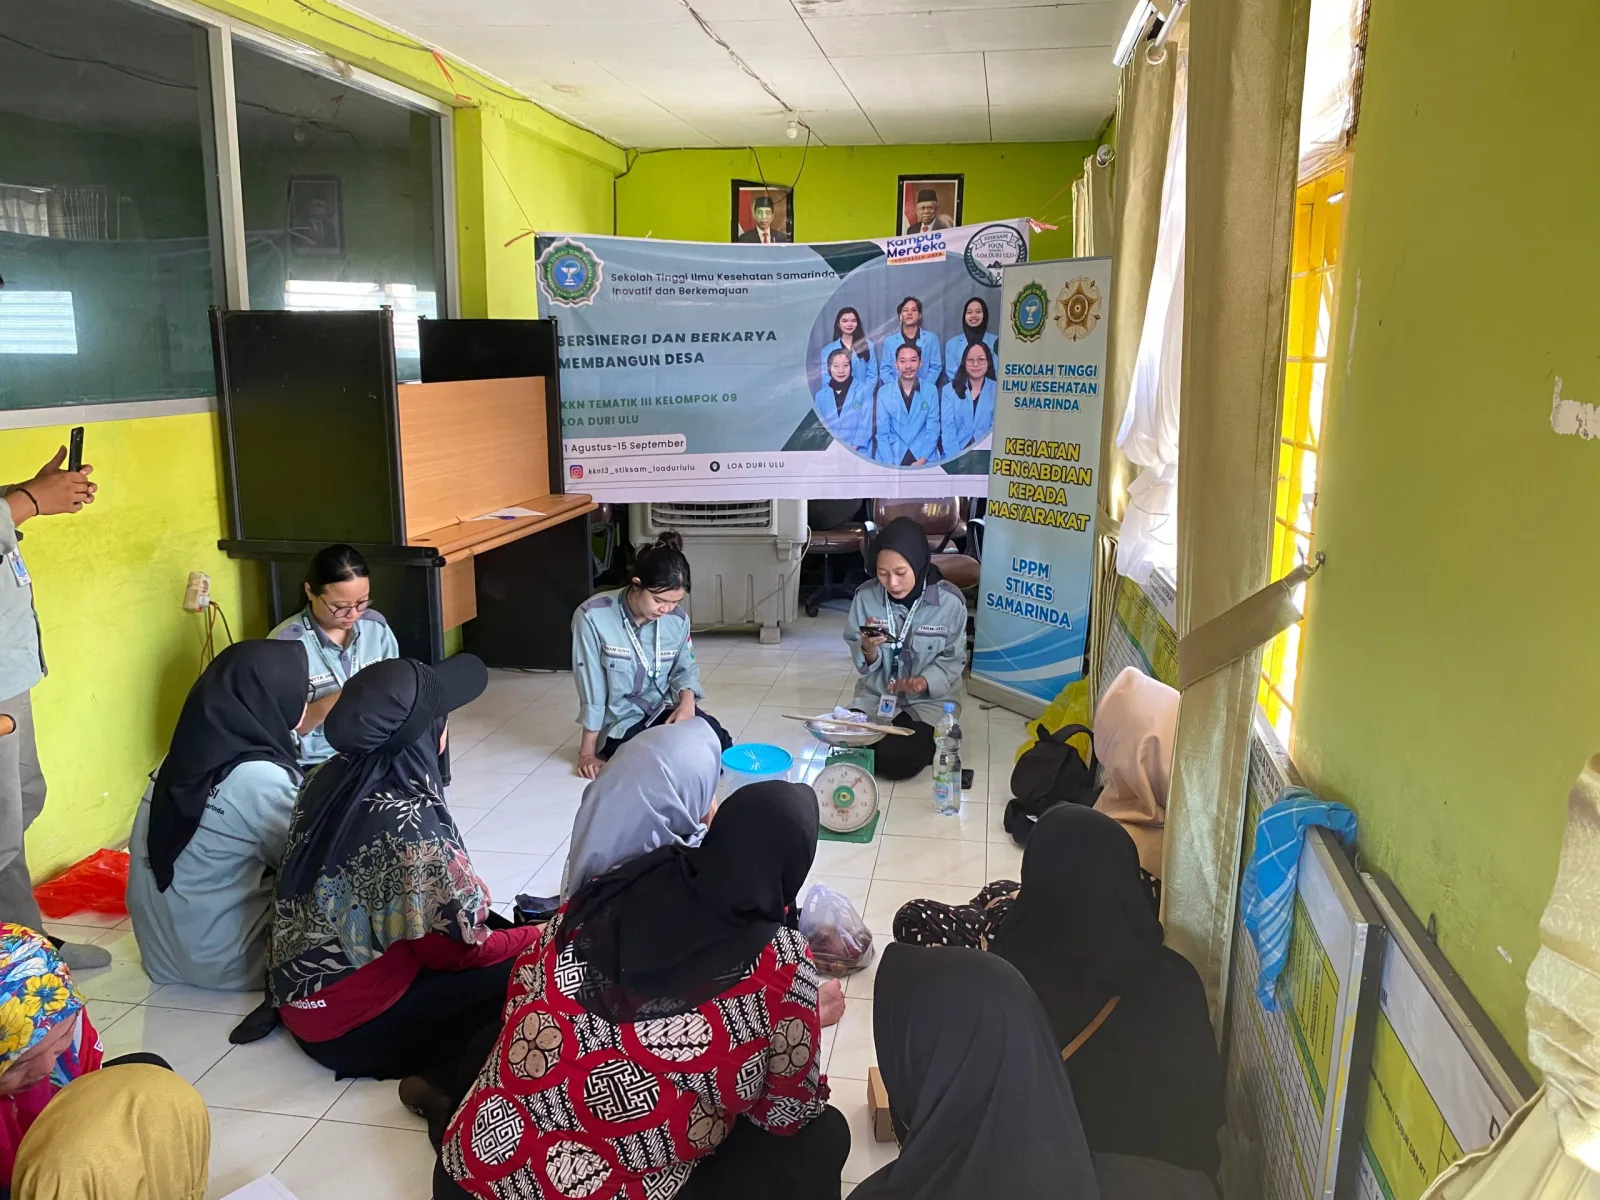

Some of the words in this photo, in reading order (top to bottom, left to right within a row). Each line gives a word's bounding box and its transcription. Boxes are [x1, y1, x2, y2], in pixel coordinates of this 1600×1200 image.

[887, 232, 942, 248] Kampus
[887, 241, 946, 258] Merdeka
[611, 272, 653, 282] Sekolah
[656, 272, 688, 284] Tinggi
[691, 272, 714, 281] Ilmu
[717, 272, 774, 281] Kesehatan
[776, 269, 835, 280] Samarinda
[612, 286, 653, 296] Inovatif
[655, 286, 676, 295] dan
[679, 286, 749, 297] Berkemajuan
[557, 334, 647, 347] BERSINERGI
[651, 333, 686, 344] DAN
[690, 330, 777, 343] BERKARYA
[559, 354, 661, 369] MEMBANGUN
[664, 352, 705, 365] DESA
[1005, 363, 1054, 376] SEKOLAH
[1058, 364, 1098, 377] TINGGI
[1002, 380, 1028, 392] ILMU
[1030, 381, 1098, 395] KESEHATAN
[561, 400, 585, 410] KKN
[588, 398, 638, 409] TEMATIK
[640, 397, 652, 406] III
[655, 393, 718, 406] KELOMPOK
[722, 393, 738, 402] 09
[1013, 396, 1080, 411] SAMARINDA
[561, 417, 584, 427] LOA
[588, 416, 615, 426] DURI
[618, 415, 639, 424] ULU
[571, 441, 627, 454] Agustus-15
[629, 439, 685, 451] September
[1005, 438, 1081, 461] KEGIATAN
[727, 462, 743, 470] LOA
[993, 458, 1092, 486] PENGABDIAN
[1008, 481, 1068, 506] KEPADA
[988, 500, 1090, 532] MASYARAKAT
[1012, 556, 1050, 579] LPPM
[1005, 576, 1053, 601] STIKES
[986, 592, 1071, 628] SAMARINDA
[205, 803, 225, 815] arinda
